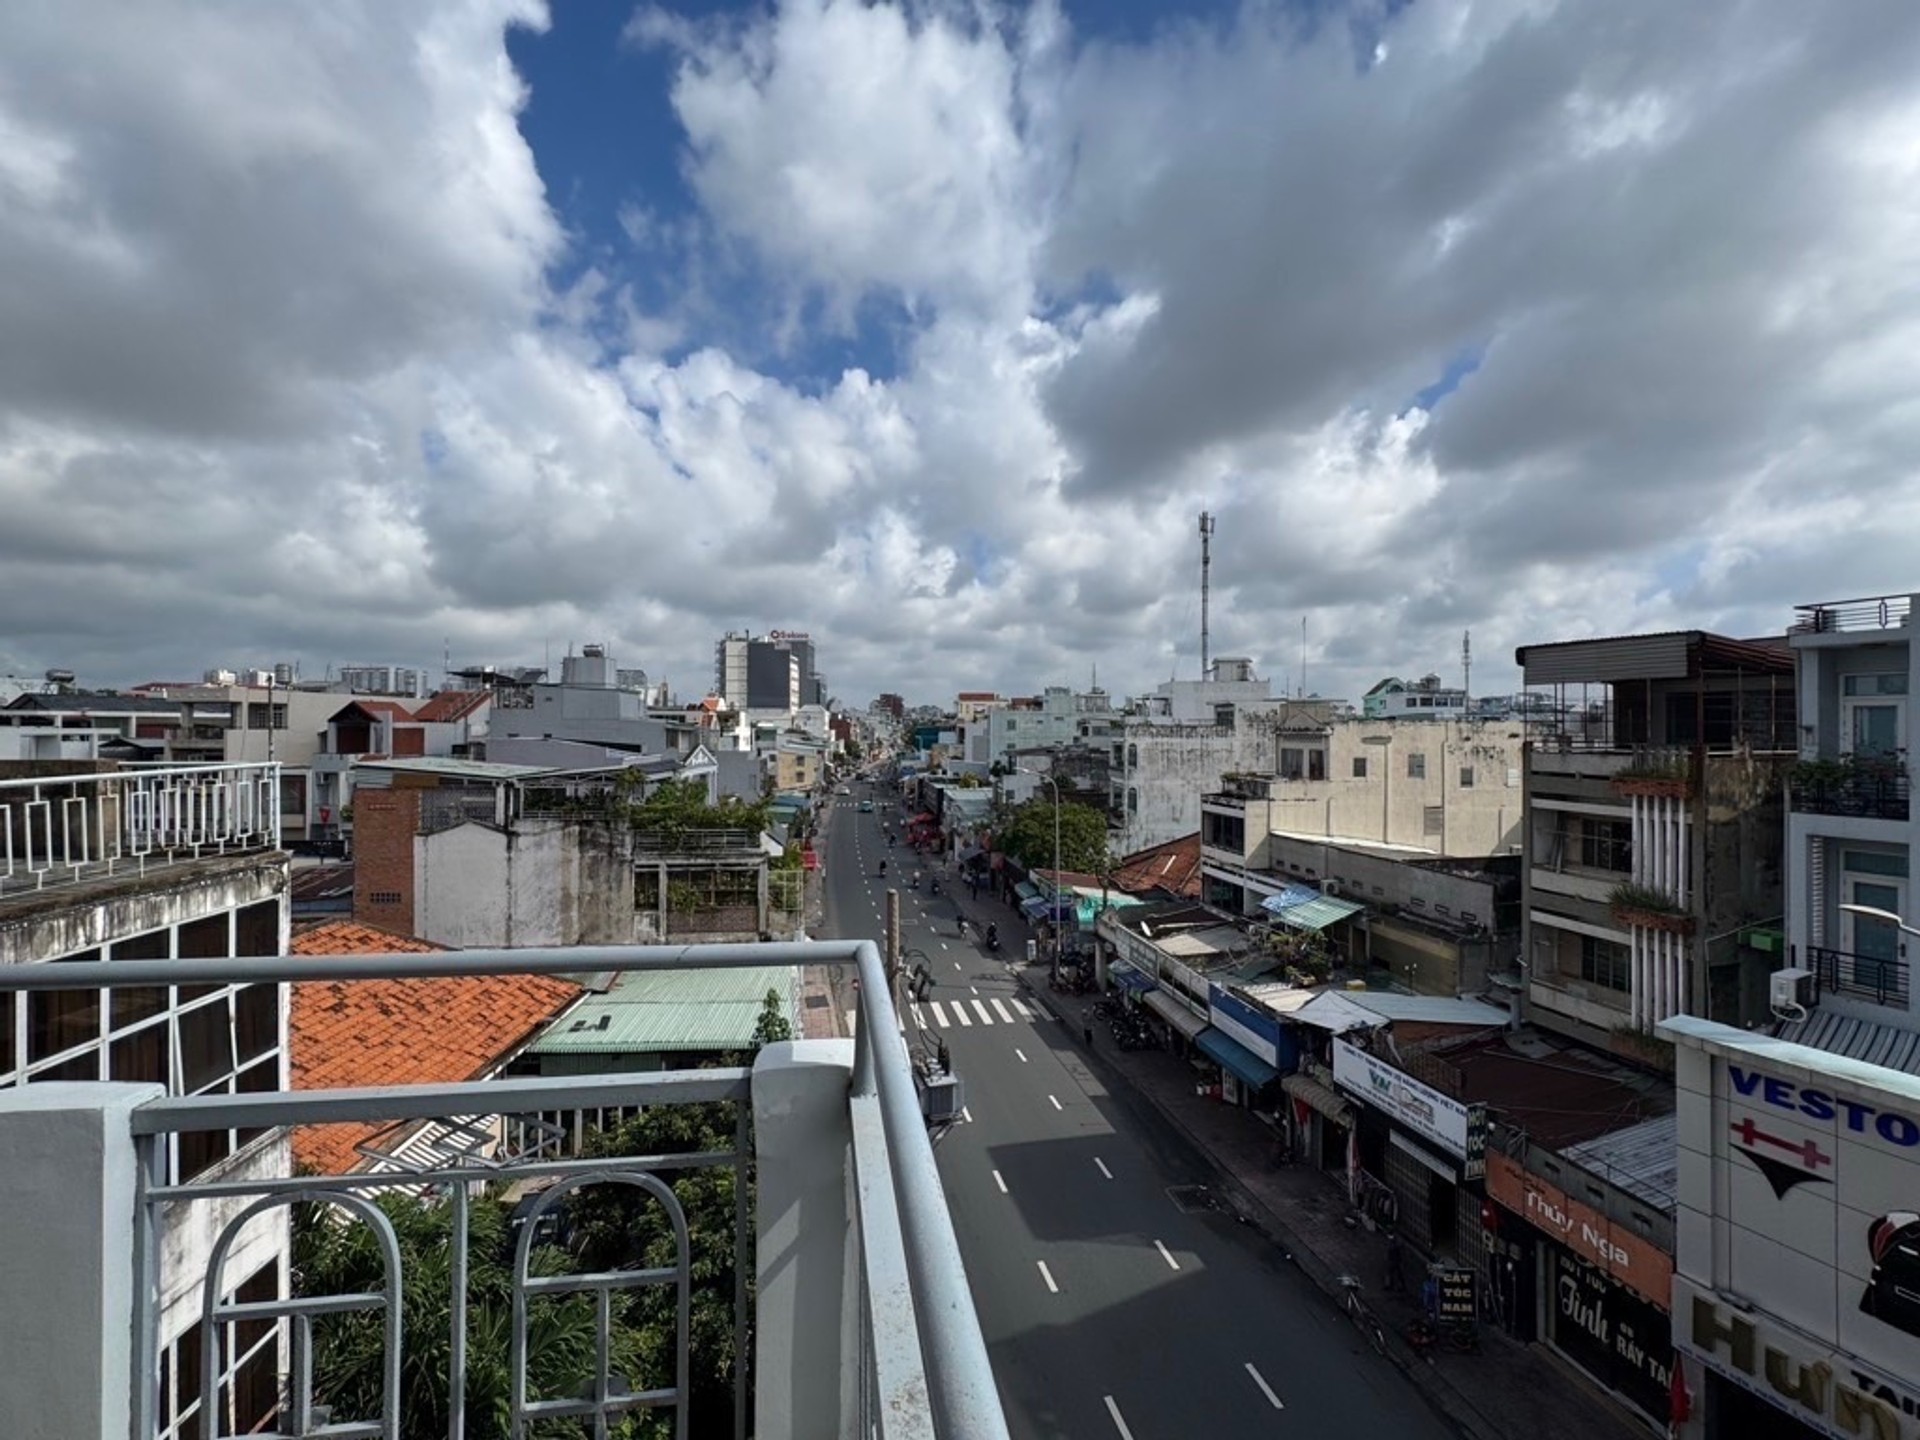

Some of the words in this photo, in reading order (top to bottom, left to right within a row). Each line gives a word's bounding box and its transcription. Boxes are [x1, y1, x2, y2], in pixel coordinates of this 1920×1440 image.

[1728, 1065, 1920, 1147] VESTO
[1582, 1222, 1629, 1267] Nga
[1443, 1286, 1472, 1299] TÓC
[1558, 1274, 1612, 1344] Tình
[1616, 1333, 1645, 1369] RÁY
